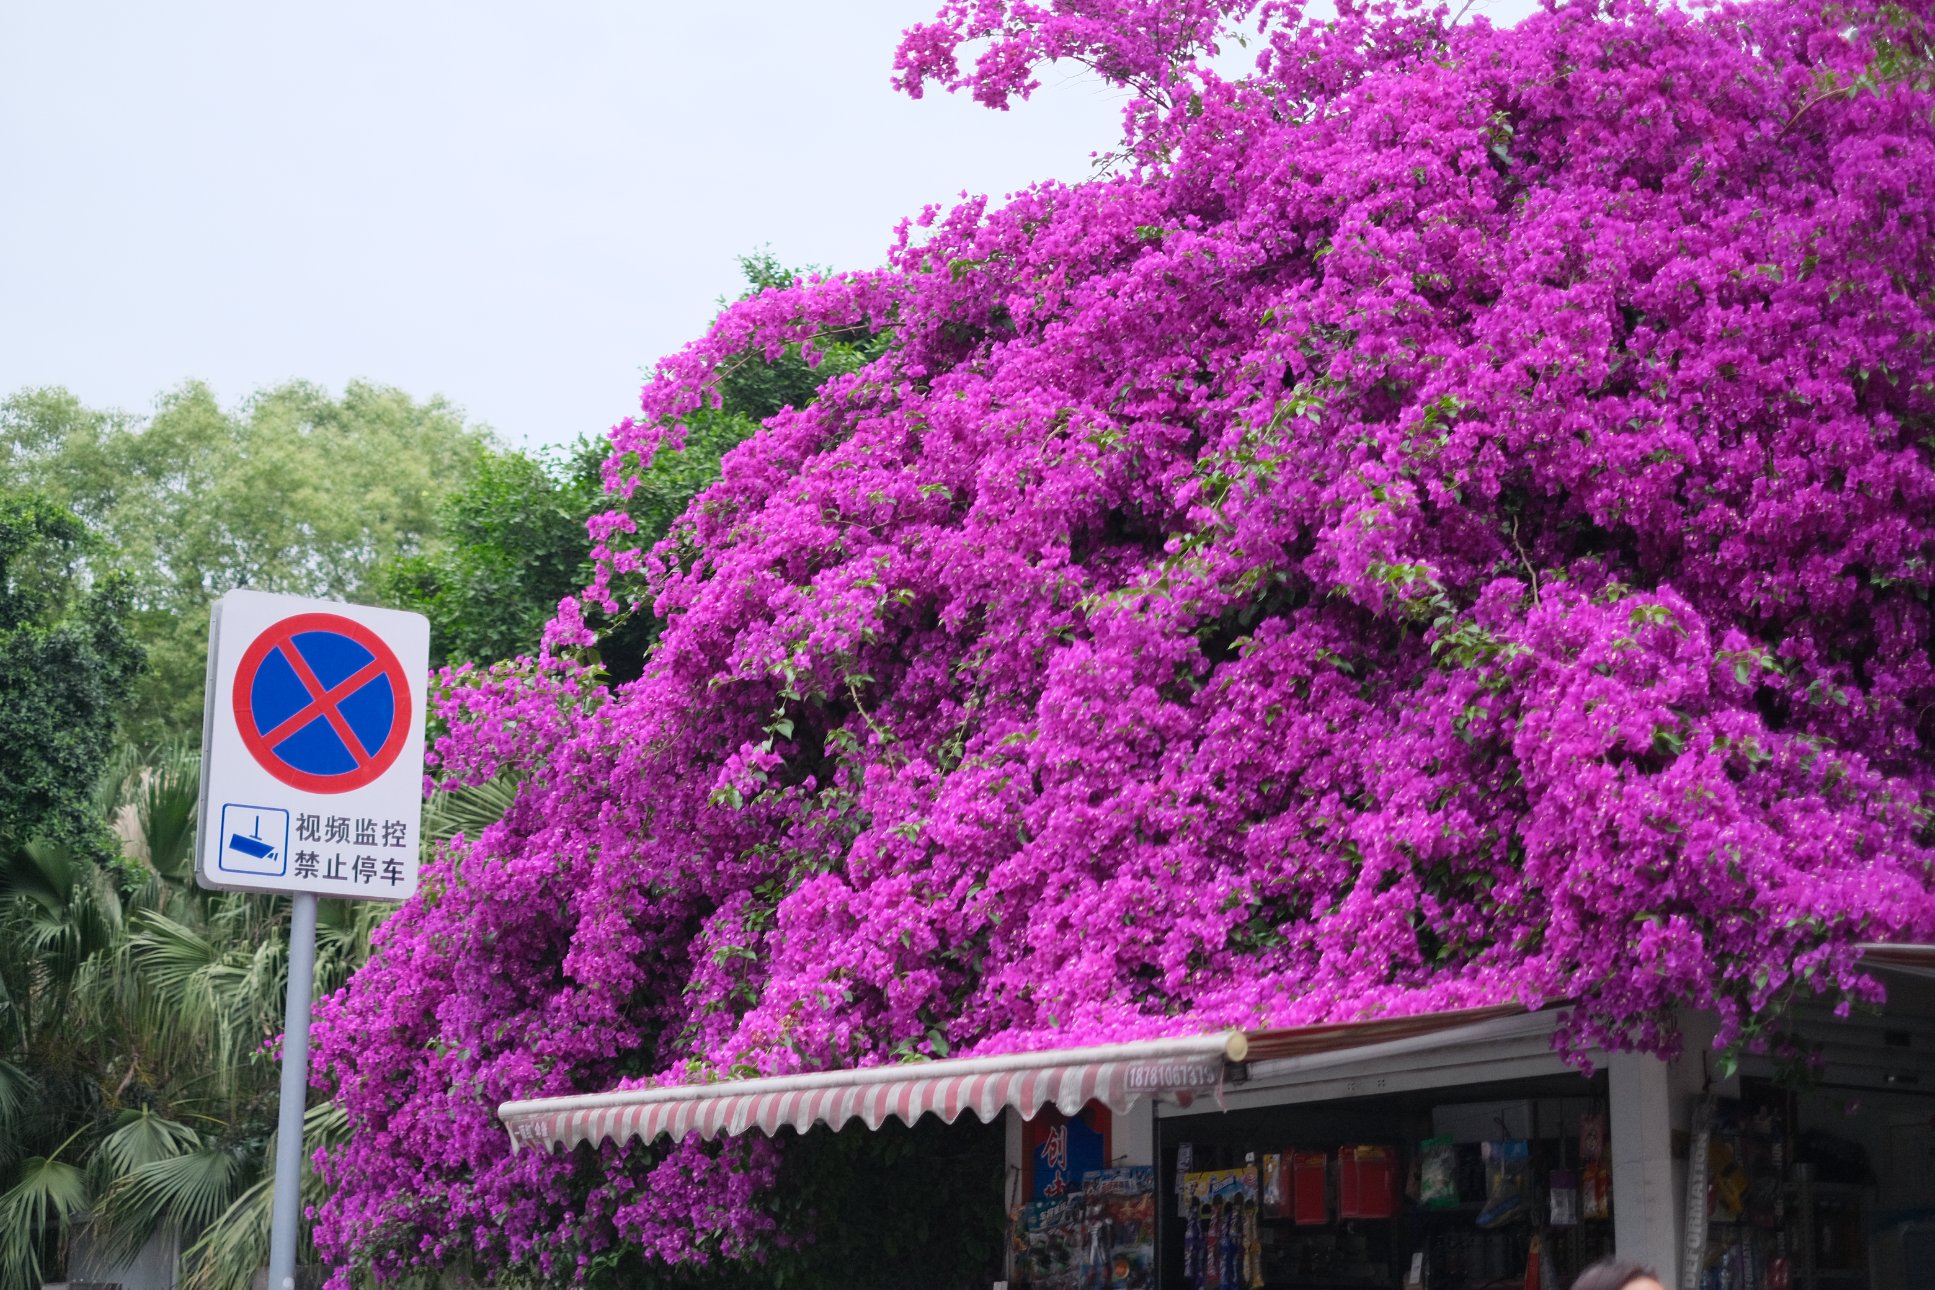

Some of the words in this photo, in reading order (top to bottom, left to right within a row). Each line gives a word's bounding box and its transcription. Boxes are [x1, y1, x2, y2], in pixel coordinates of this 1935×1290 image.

[296, 813, 407, 848] 视频监控
[294, 850, 405, 886] 禁止停车
